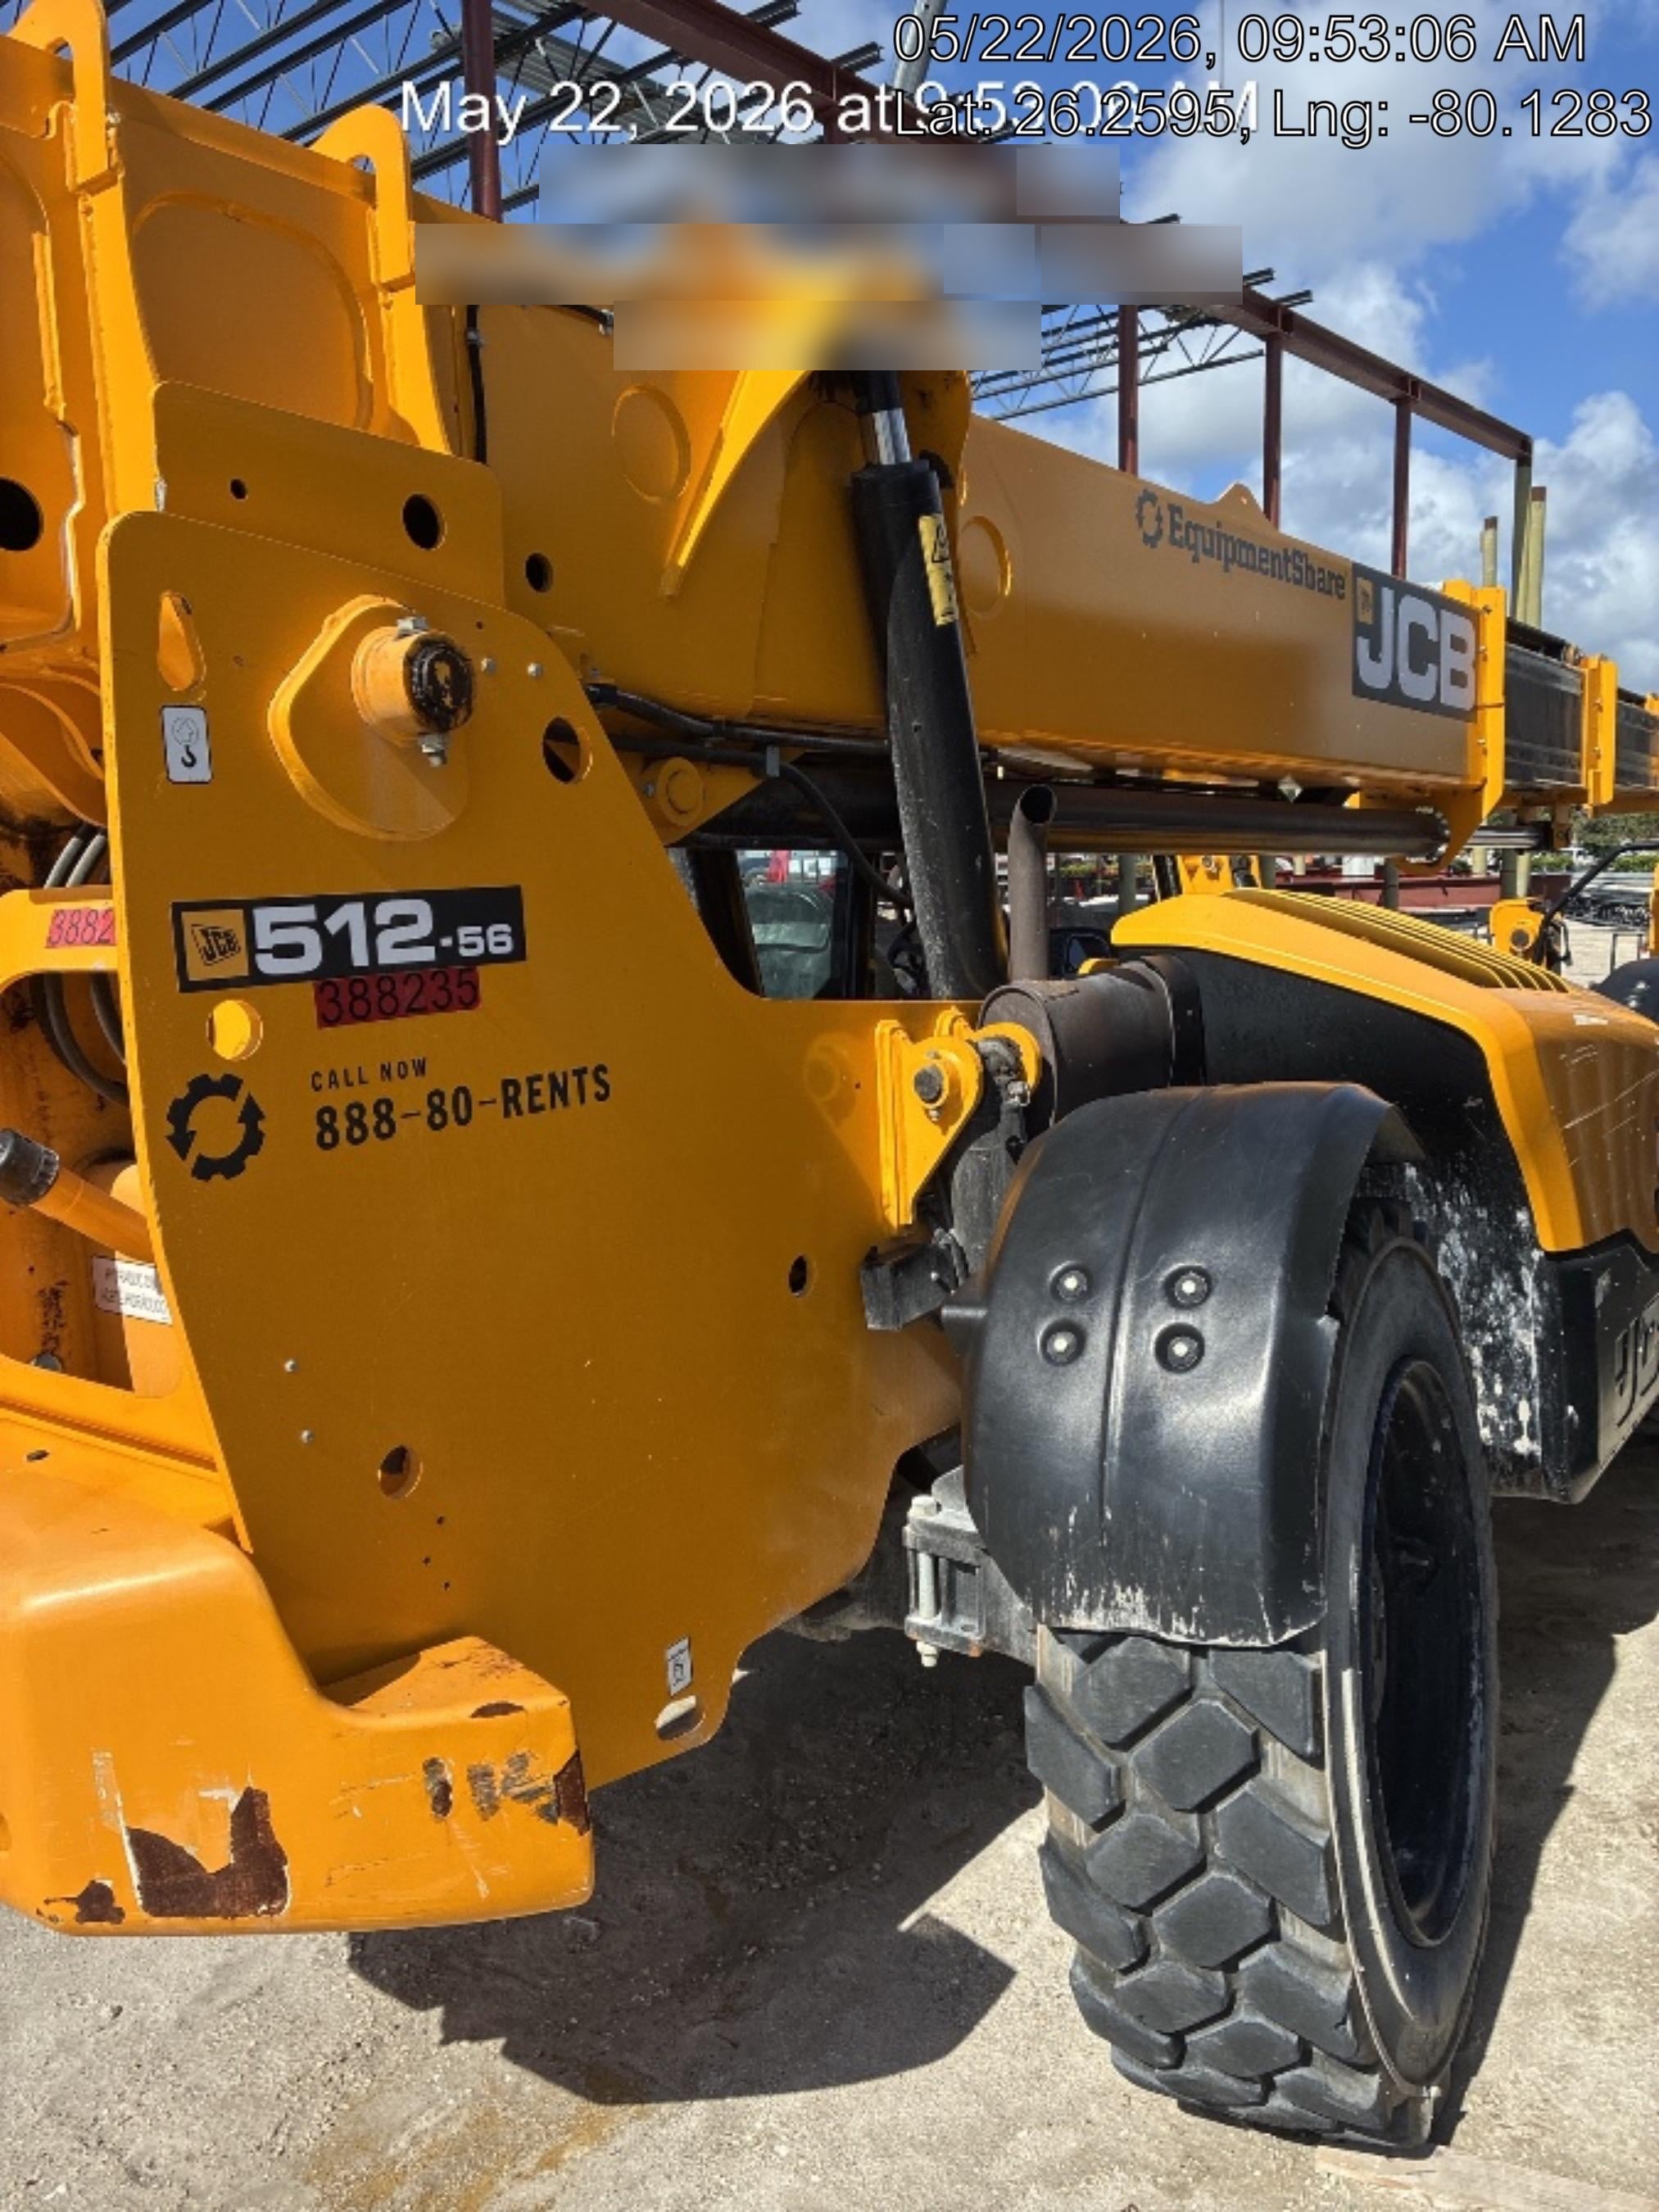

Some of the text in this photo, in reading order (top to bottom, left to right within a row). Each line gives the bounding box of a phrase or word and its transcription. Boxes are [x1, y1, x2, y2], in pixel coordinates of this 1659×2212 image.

[1167, 503, 1346, 601] EquipmentShare
[1356, 586, 1475, 712] JCB
[195, 926, 239, 963] JCB
[319, 966, 478, 1024] 388235
[311, 1057, 428, 1092] CALL NOW
[315, 1063, 611, 1151] 888-80-RENTS
